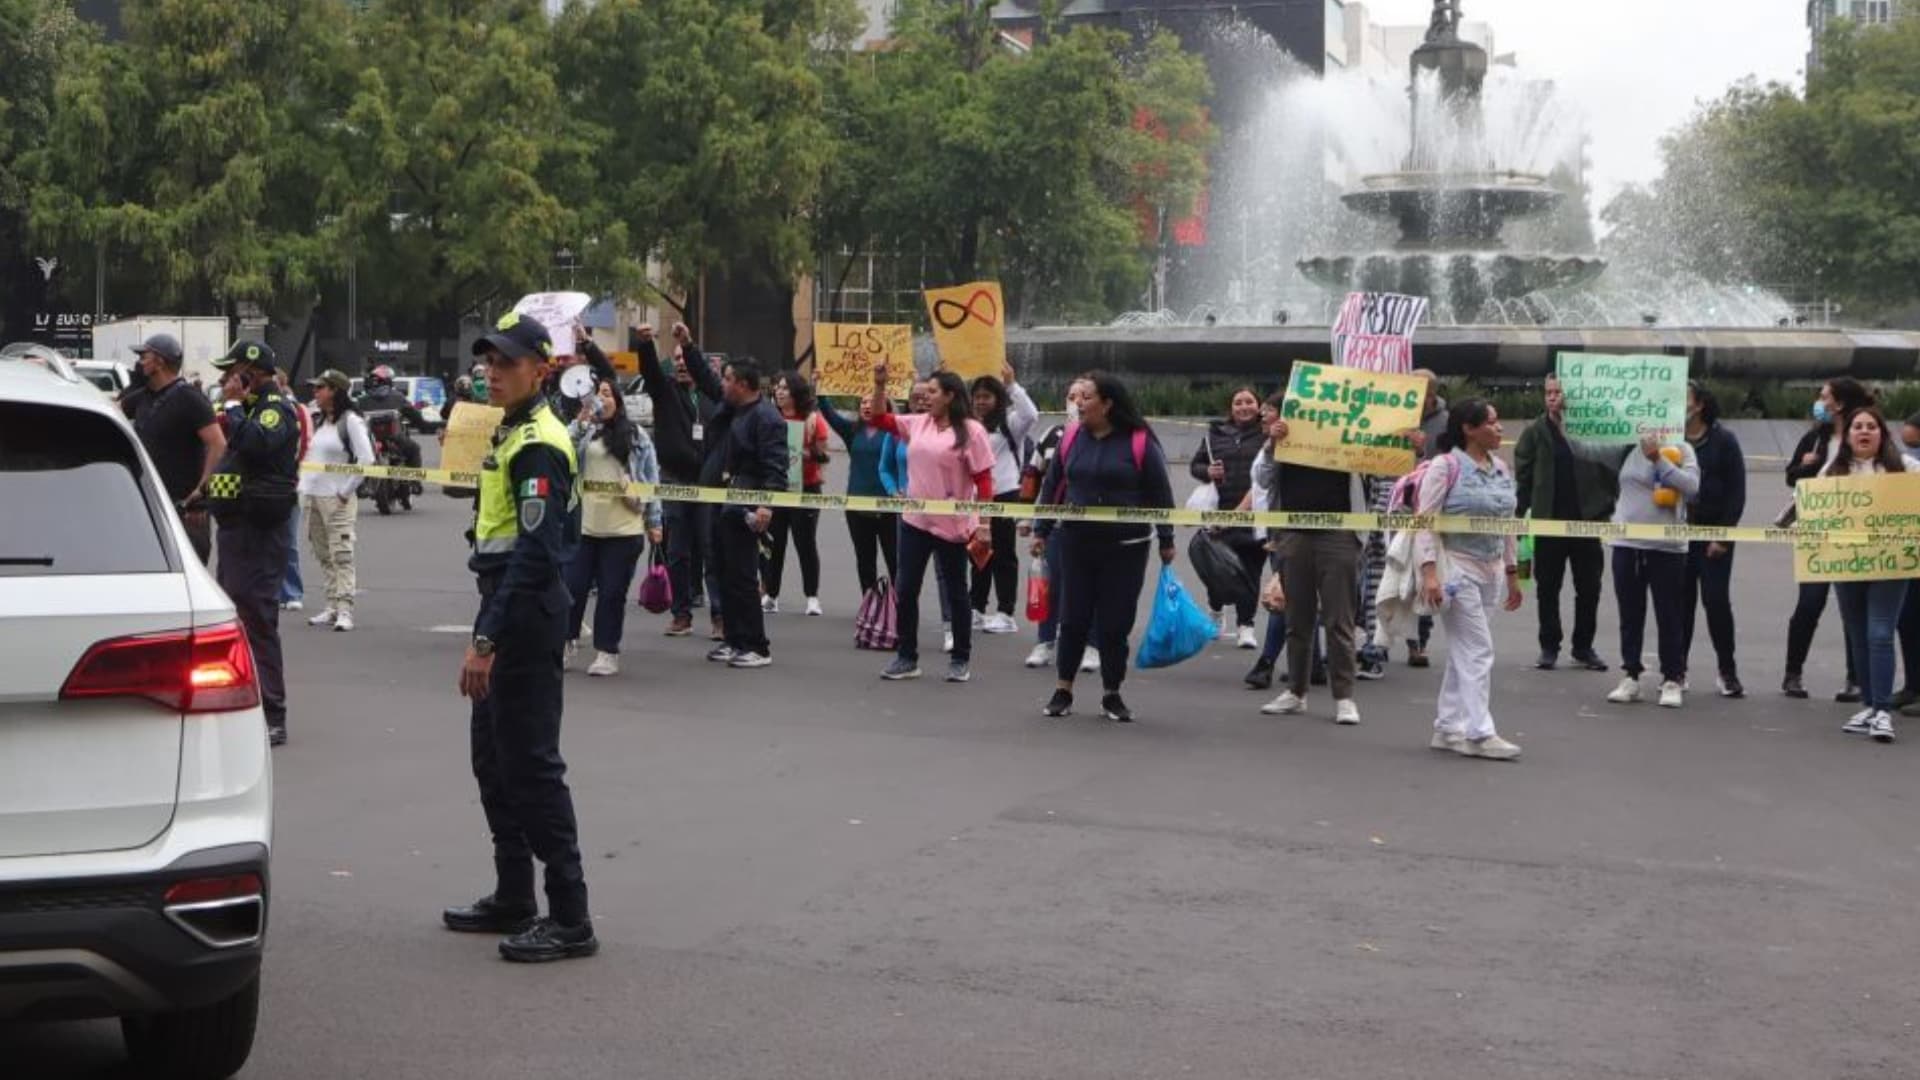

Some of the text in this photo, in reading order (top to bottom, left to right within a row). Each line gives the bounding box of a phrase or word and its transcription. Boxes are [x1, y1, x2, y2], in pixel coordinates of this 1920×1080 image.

[1559, 355, 1672, 381] La maestra
[1565, 381, 1641, 401] uchando
[1625, 398, 1670, 418] está
[1797, 479, 1873, 510] Nosotros
[1808, 546, 1897, 573] Guardería
[1902, 545, 1920, 572] 3
